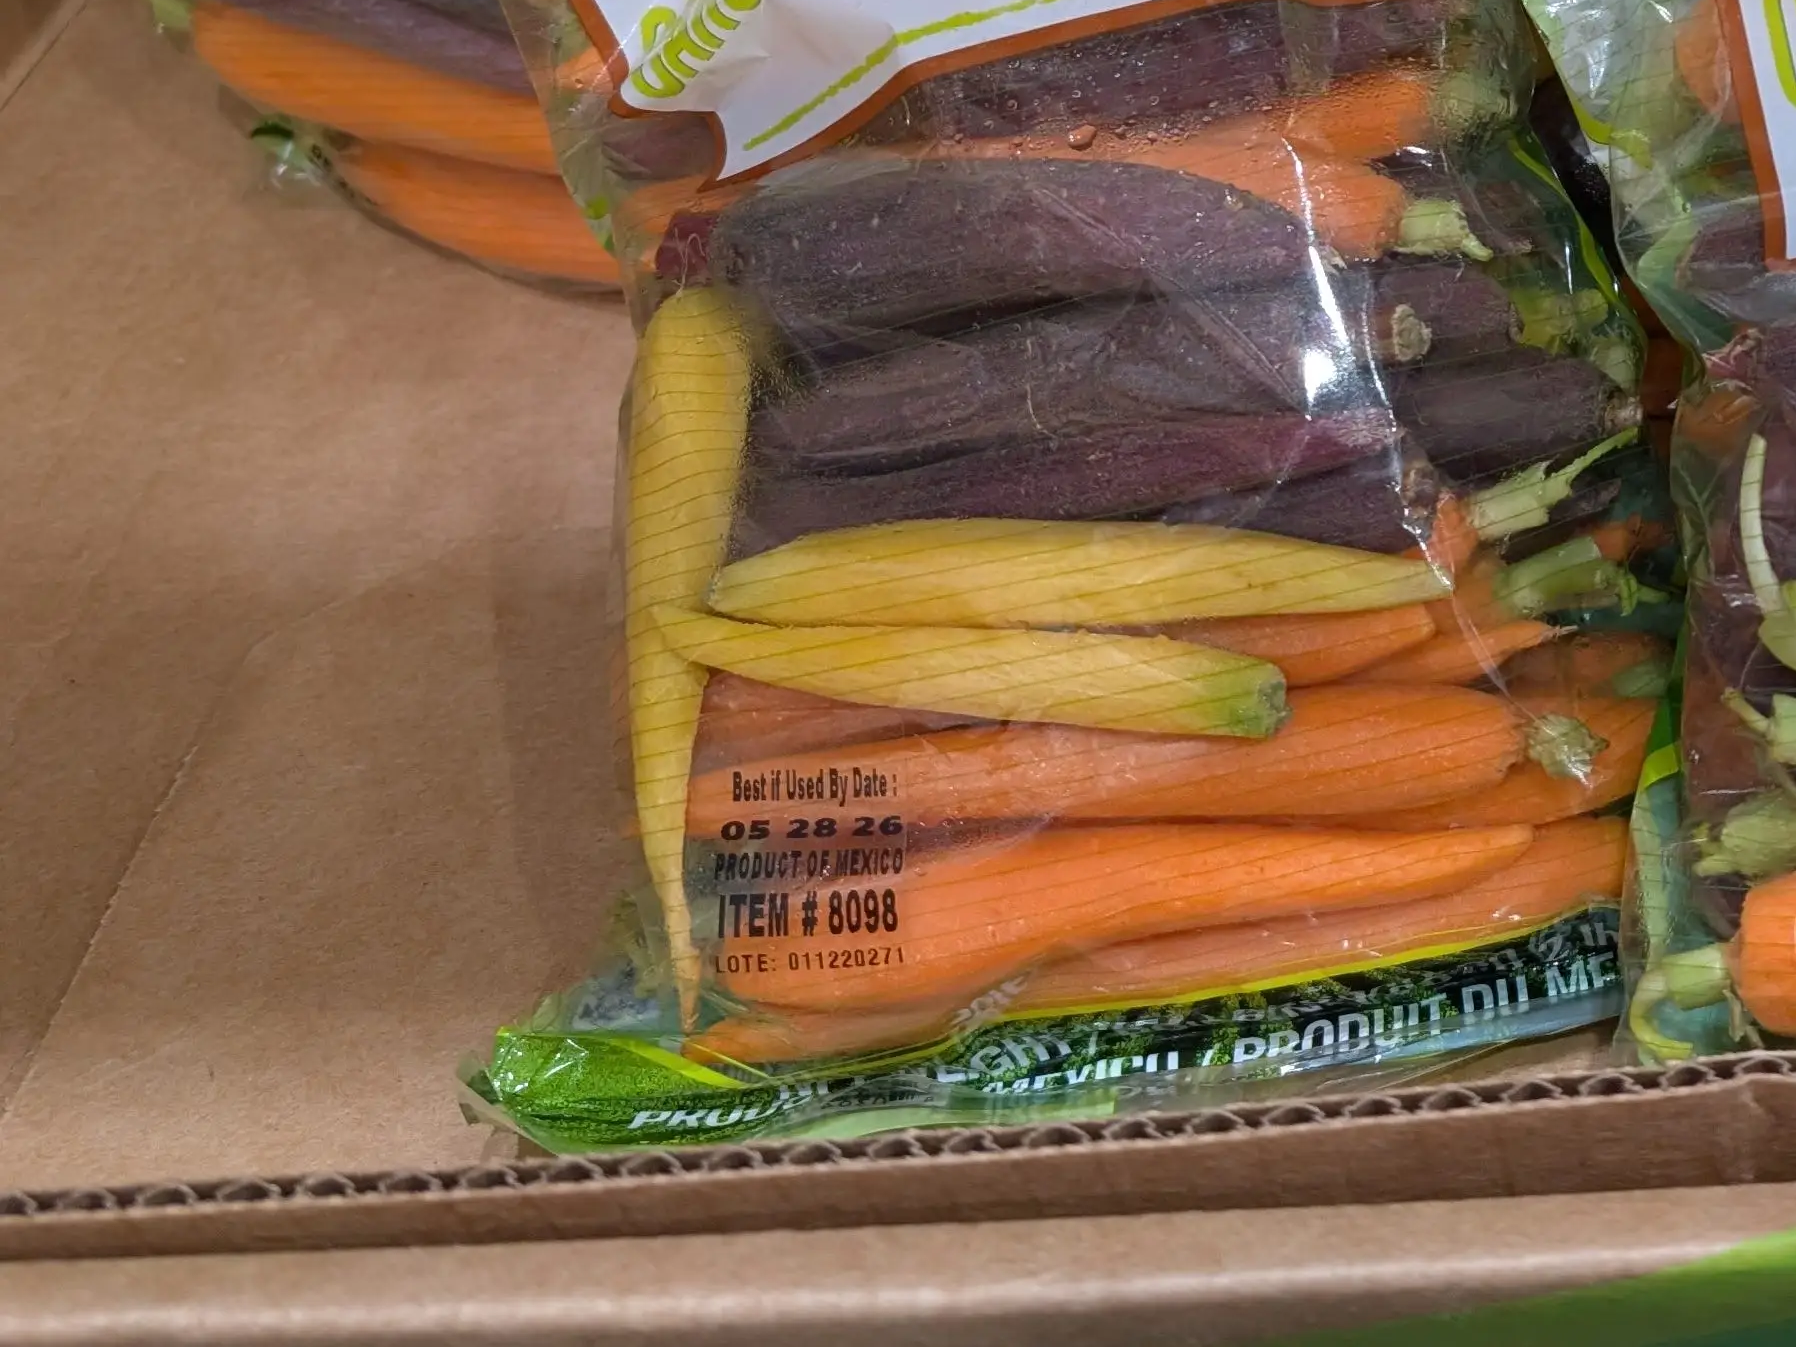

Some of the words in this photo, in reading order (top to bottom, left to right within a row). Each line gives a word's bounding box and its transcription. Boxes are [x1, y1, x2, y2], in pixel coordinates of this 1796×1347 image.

[732, 771, 767, 802] Best
[771, 769, 781, 801] if
[786, 769, 824, 800] Used
[829, 767, 848, 807] By
[853, 766, 887, 797] Date
[720, 819, 771, 841] 05
[786, 817, 837, 839] 28
[852, 815, 903, 837] 26
[714, 850, 802, 881] PRODUCT
[806, 851, 831, 879] OF
[836, 848, 903, 876] MEXICO
[718, 892, 790, 939] ITEM
[802, 890, 818, 937] #
[828, 888, 899, 935] 8098
[715, 952, 777, 974] LOTE:
[788, 947, 905, 971] 011220271
